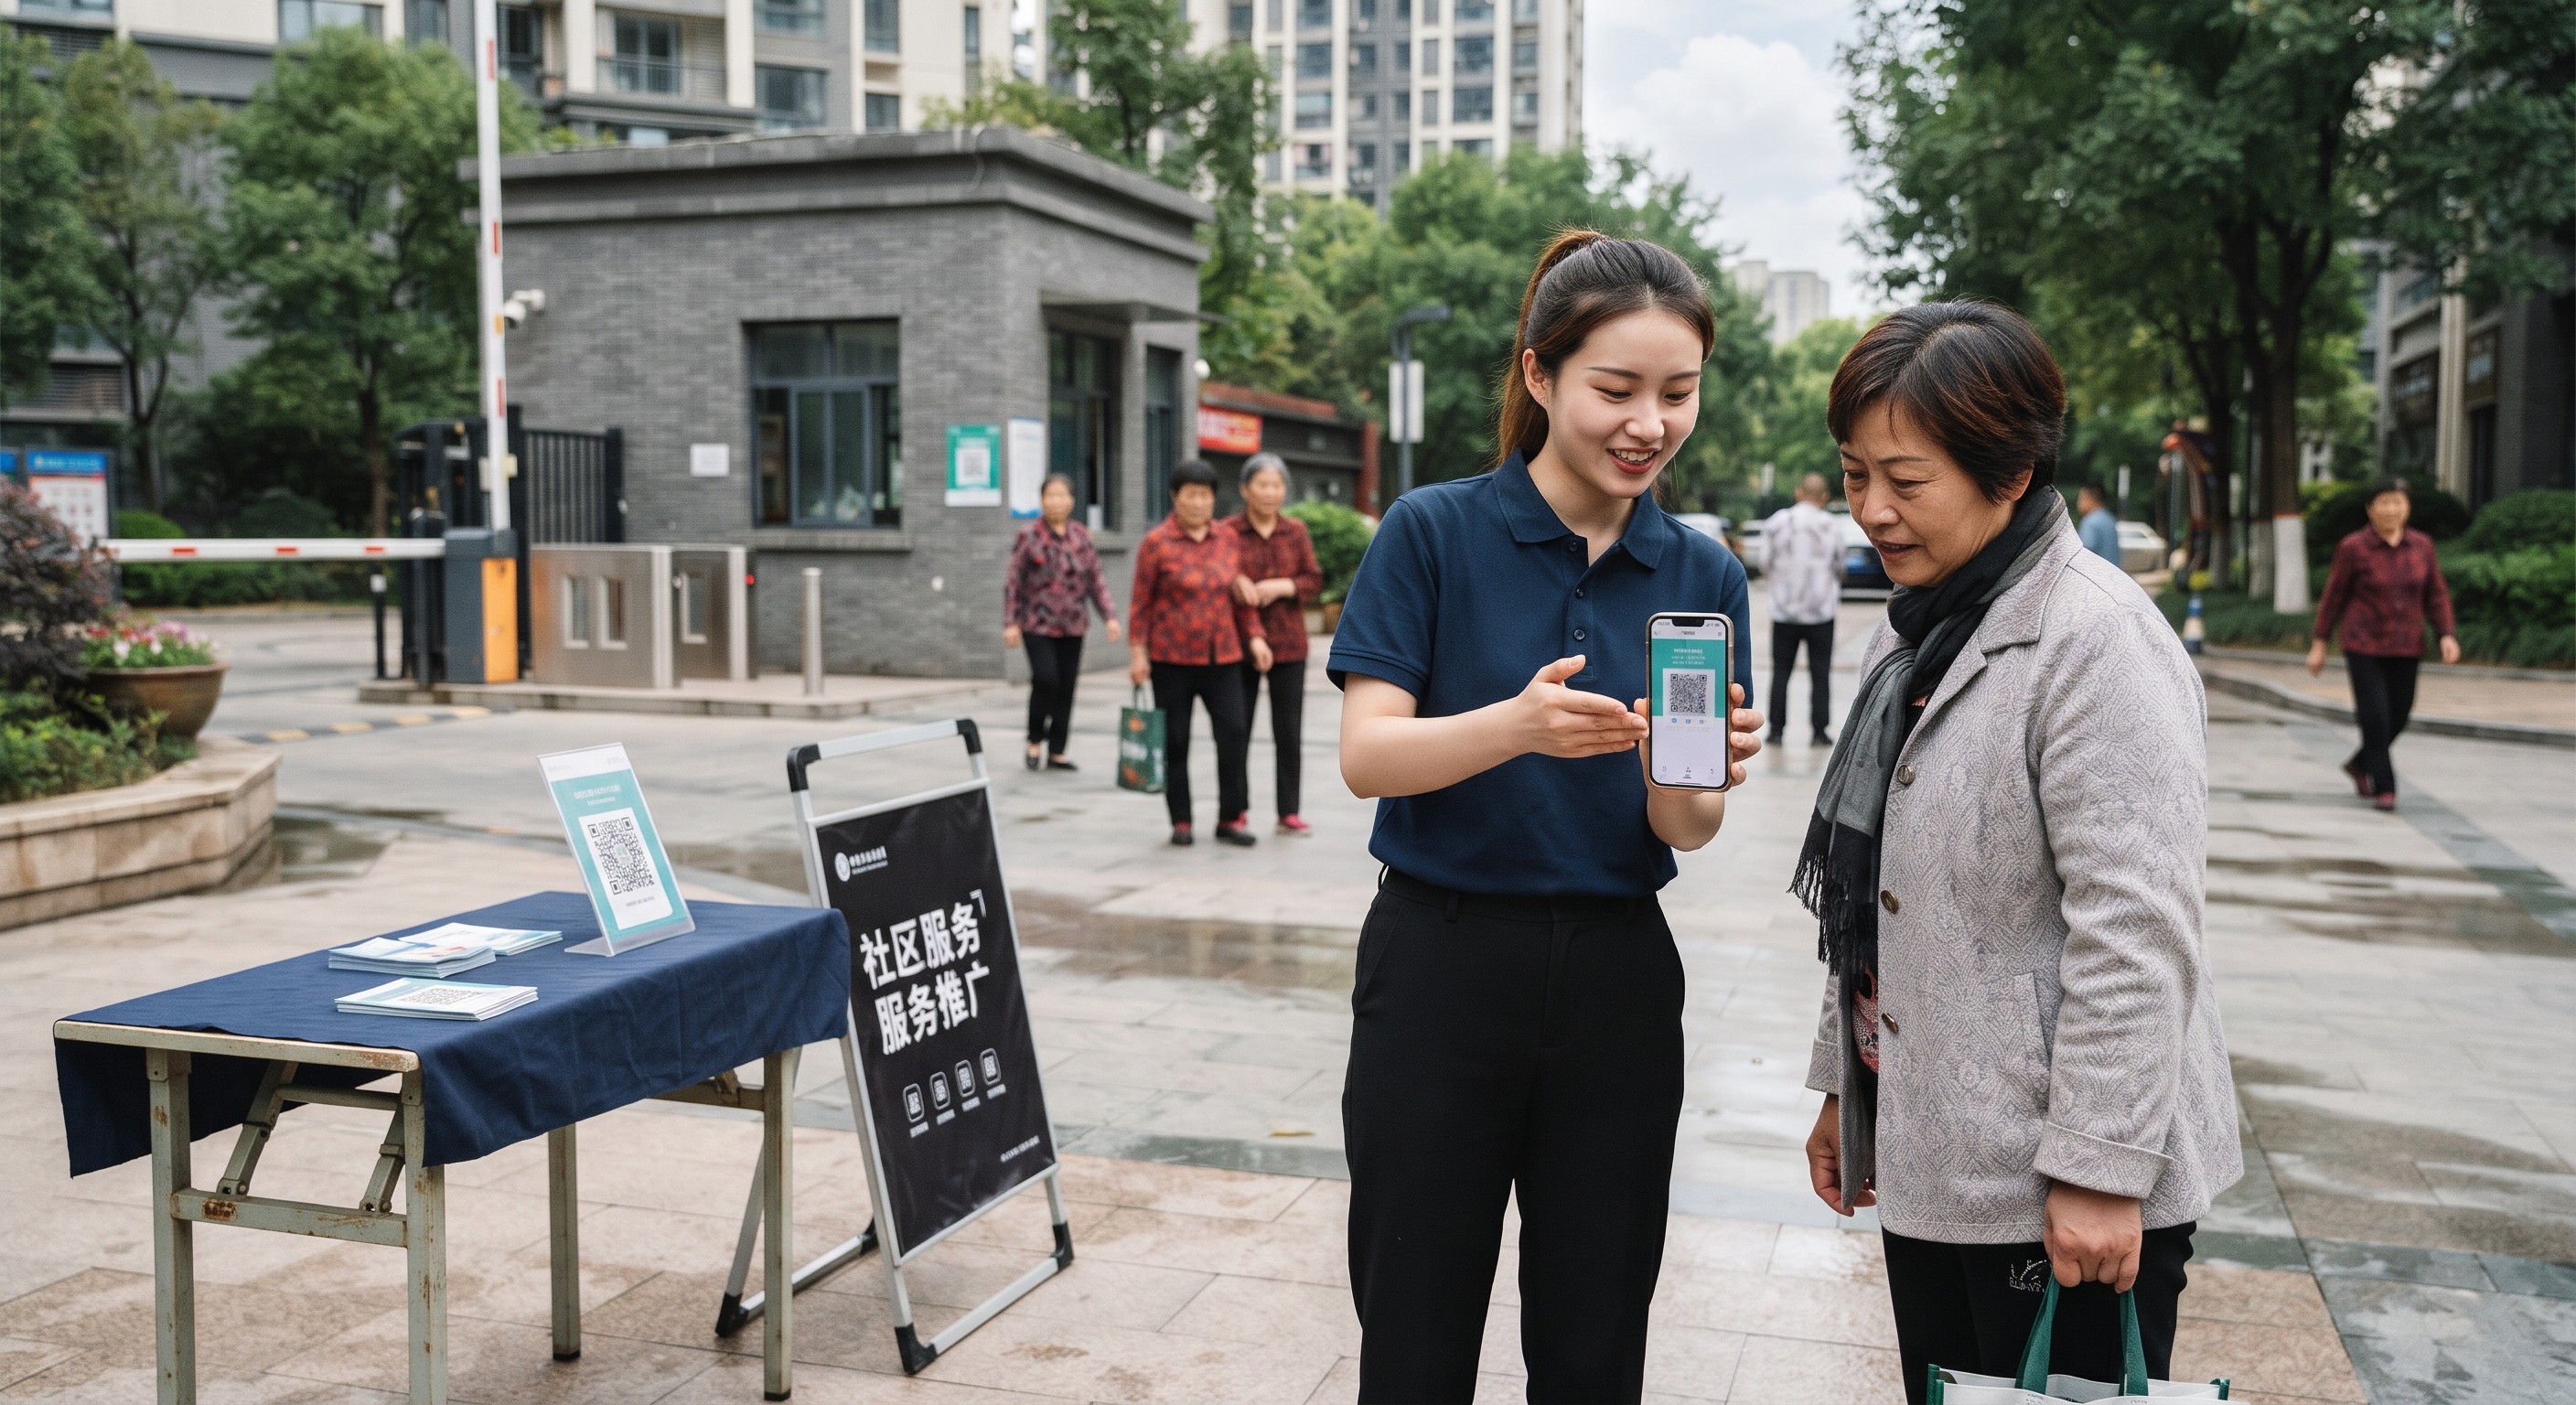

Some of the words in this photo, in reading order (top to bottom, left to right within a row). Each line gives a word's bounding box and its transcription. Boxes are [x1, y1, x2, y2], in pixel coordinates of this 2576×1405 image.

[859, 902, 981, 991] 社区服务
[875, 960, 991, 1056] 服务推广
